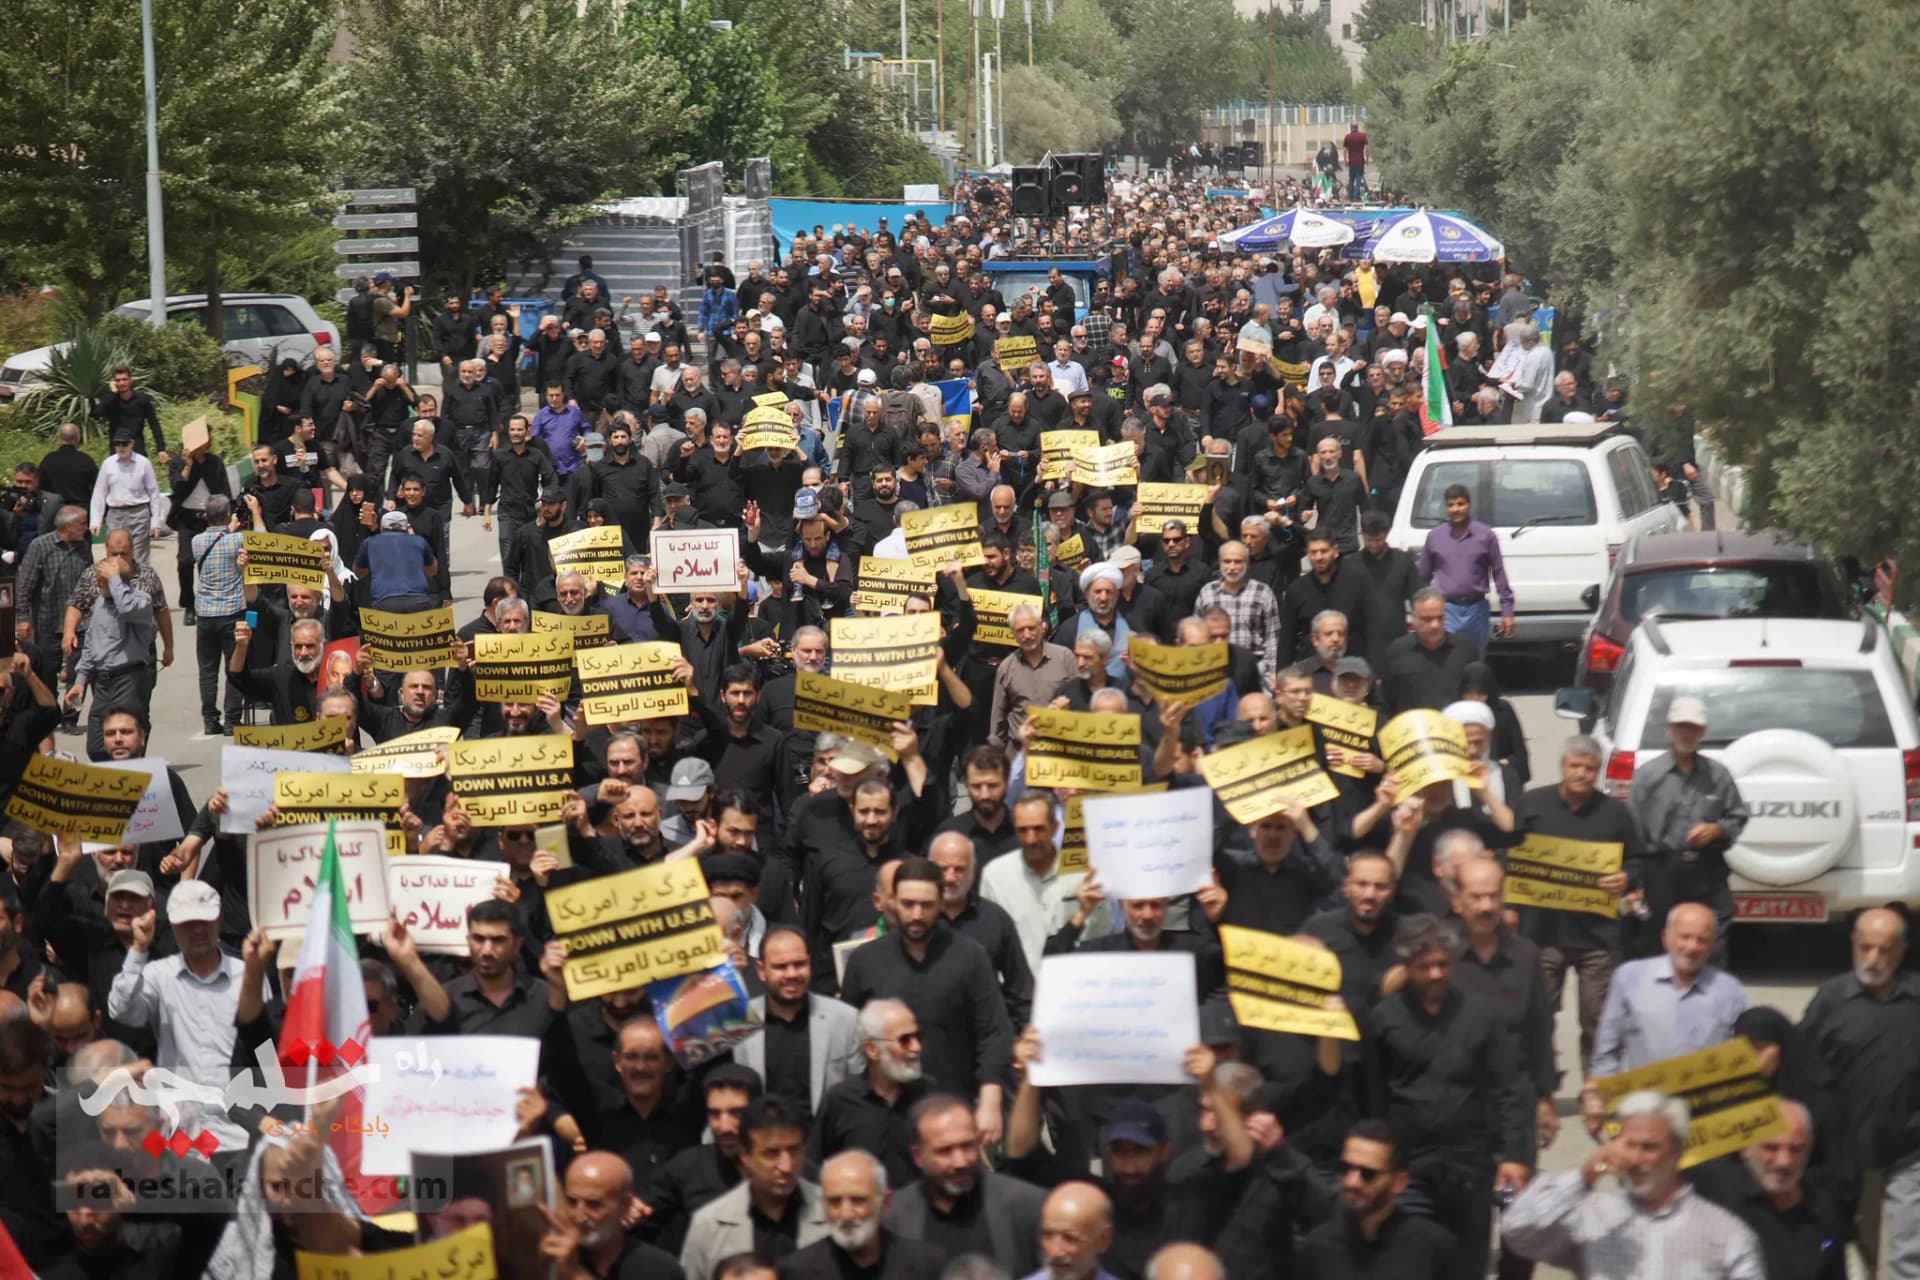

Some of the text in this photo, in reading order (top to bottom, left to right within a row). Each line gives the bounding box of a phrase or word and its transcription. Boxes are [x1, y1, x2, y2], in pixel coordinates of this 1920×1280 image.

[1164, 504, 1185, 513] WITH
[904, 510, 974, 532] مرگ بر امریکا
[247, 535, 322, 553] مرگ بر امریکا
[590, 534, 596, 545] بر
[600, 531, 618, 542] مرگ
[907, 531, 978, 549] DOWN WITH U.S.A
[678, 542, 701, 551] فداک
[704, 540, 719, 551] کلنا
[276, 555, 298, 564] WITH
[555, 550, 622, 561] DOWN WITH ISRAEL
[247, 567, 322, 584] الموت لامریکا
[597, 562, 623, 578] الموت
[673, 558, 719, 583] اسلام
[862, 561, 893, 576] امریکا
[859, 580, 885, 589] DOWN
[887, 582, 910, 591] WITH
[364, 615, 450, 634] مرگ بر امریکا
[535, 616, 606, 632] مرگ امریکا
[905, 623, 935, 639] مرگ
[365, 634, 454, 648] DOWN WITH U.S.A
[478, 640, 523, 658] اسرائیل
[545, 638, 570, 656] مرگ
[585, 638, 609, 647] U.S.A
[529, 646, 540, 657] بر
[833, 646, 936, 663] DOWN WITH U.S.A
[477, 663, 570, 676] DOWN WITH ISRAEL
[583, 654, 622, 673] امریکا
[631, 658, 642, 671] بر
[583, 678, 651, 693] DOWN WITH
[801, 679, 906, 714] مرگ بر امریکا
[589, 693, 684, 717] الموت لامریکا
[239, 726, 342, 749] مرگ بر امریکا
[1084, 727, 1097, 738] بر
[1102, 721, 1135, 738] مرگ
[385, 746, 415, 754] WITH
[455, 744, 568, 771] مرگ بر امریکا
[29, 764, 142, 795] مرگ بر اسرائیل
[453, 773, 572, 792] DOWN WITH U.S.A
[1029, 763, 1139, 786] الموت لاسرائیل
[18, 784, 58, 805] DOWN
[60, 797, 90, 811] WITH
[93, 802, 132, 814] ISRAEL
[280, 783, 329, 803] امریکا
[338, 788, 352, 803] بر
[361, 781, 399, 803] مرگ
[1749, 800, 1840, 818] UZUKI
[276, 812, 320, 824] DOWN
[80, 824, 126, 839] الموت
[339, 841, 362, 857] کلنا
[413, 874, 449, 888] فداک
[453, 875, 478, 888] کلنا
[555, 872, 699, 924] مرگ بر امریکا
[564, 903, 713, 952] DOWN WITH U.S.A
[572, 935, 718, 985] الموت لامریکا
